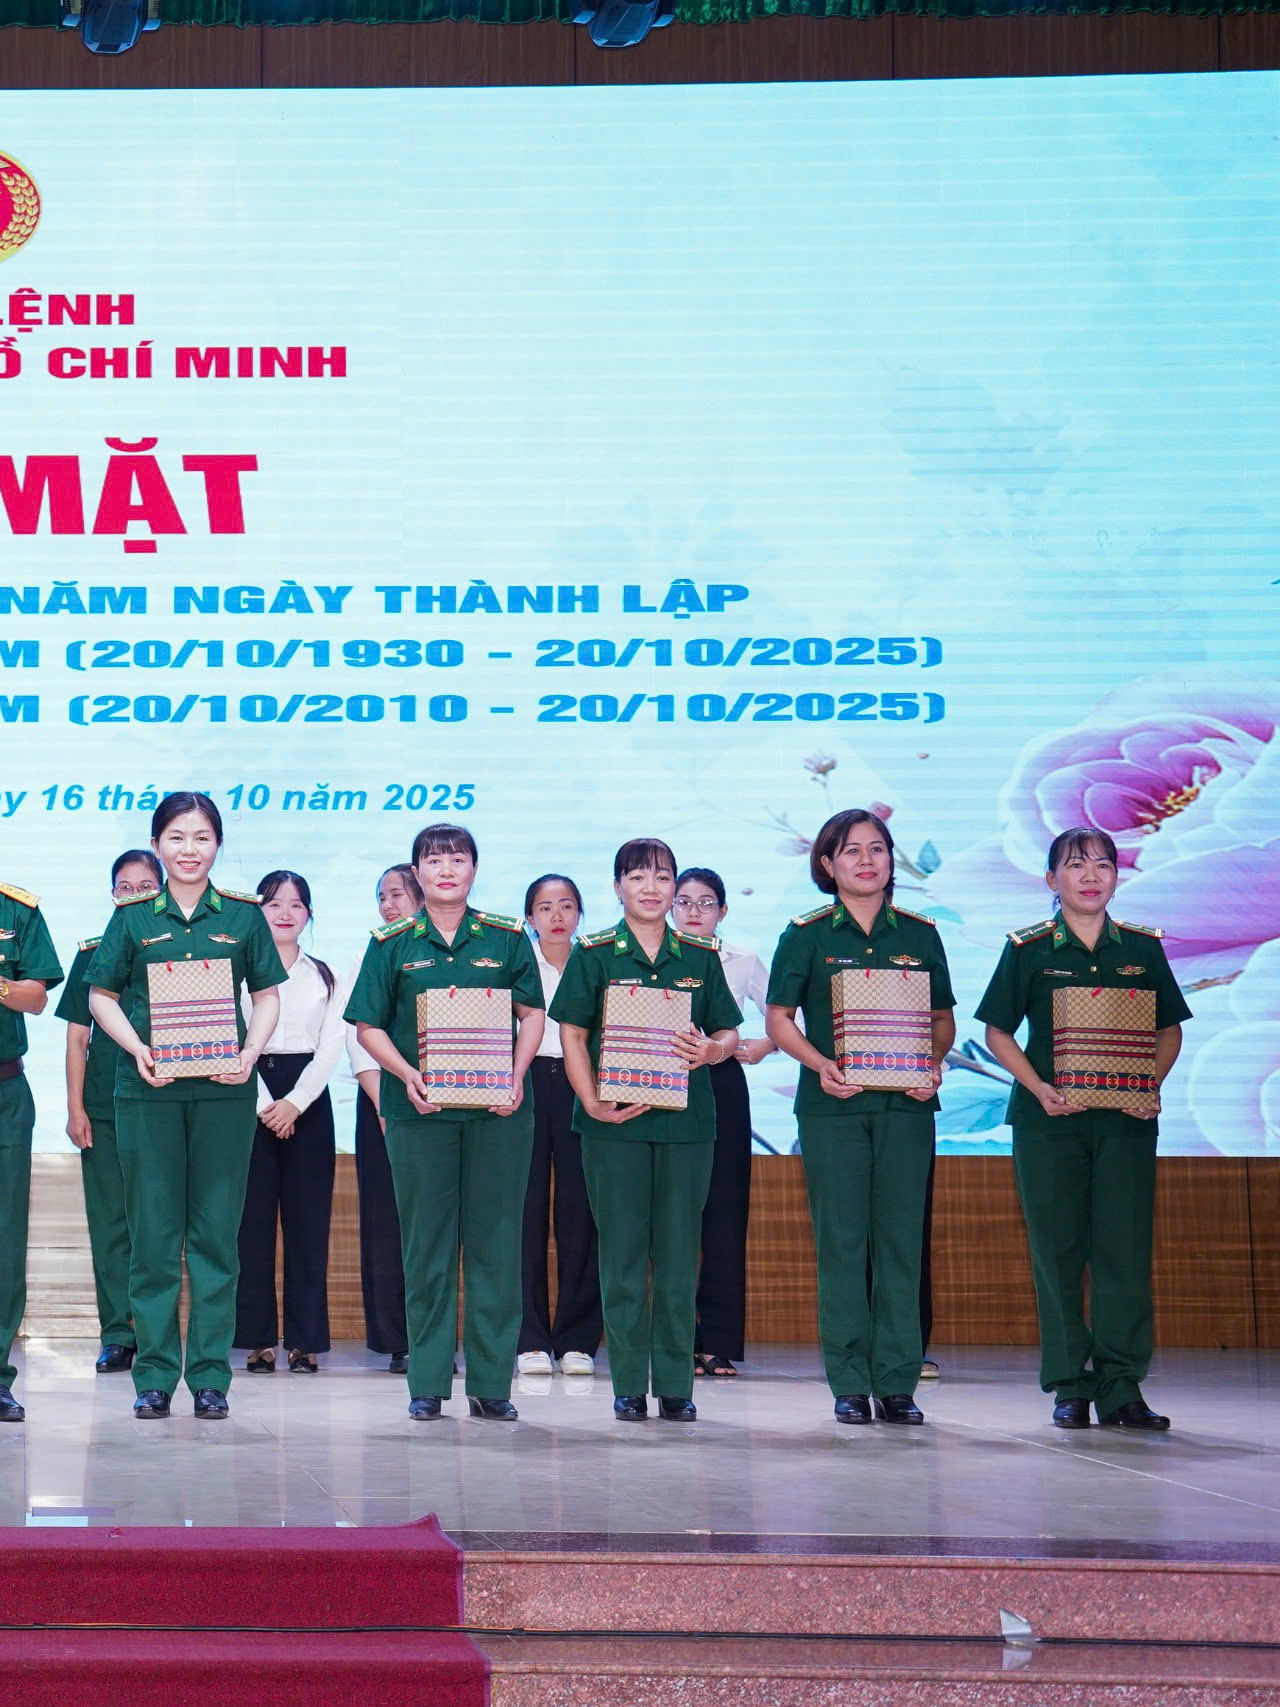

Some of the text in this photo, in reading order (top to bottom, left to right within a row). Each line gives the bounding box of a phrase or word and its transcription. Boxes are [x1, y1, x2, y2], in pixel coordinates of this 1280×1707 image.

[47, 340, 154, 379] CHÍ
[175, 346, 347, 378] MINH
[173, 579, 353, 615] NGÀY
[374, 579, 600, 614] THÀNH
[621, 578, 750, 620] LẬP
[65, 639, 465, 672] (20/10/1930
[535, 636, 944, 669] 20/10/2025)
[68, 693, 469, 727] (20/10/2010
[536, 691, 946, 724] 20/10/2025)
[41, 783, 85, 811] 16
[98, 783, 211, 812] thá
[225, 783, 271, 811] 10
[281, 783, 368, 811] năm
[382, 783, 476, 811] 2025
